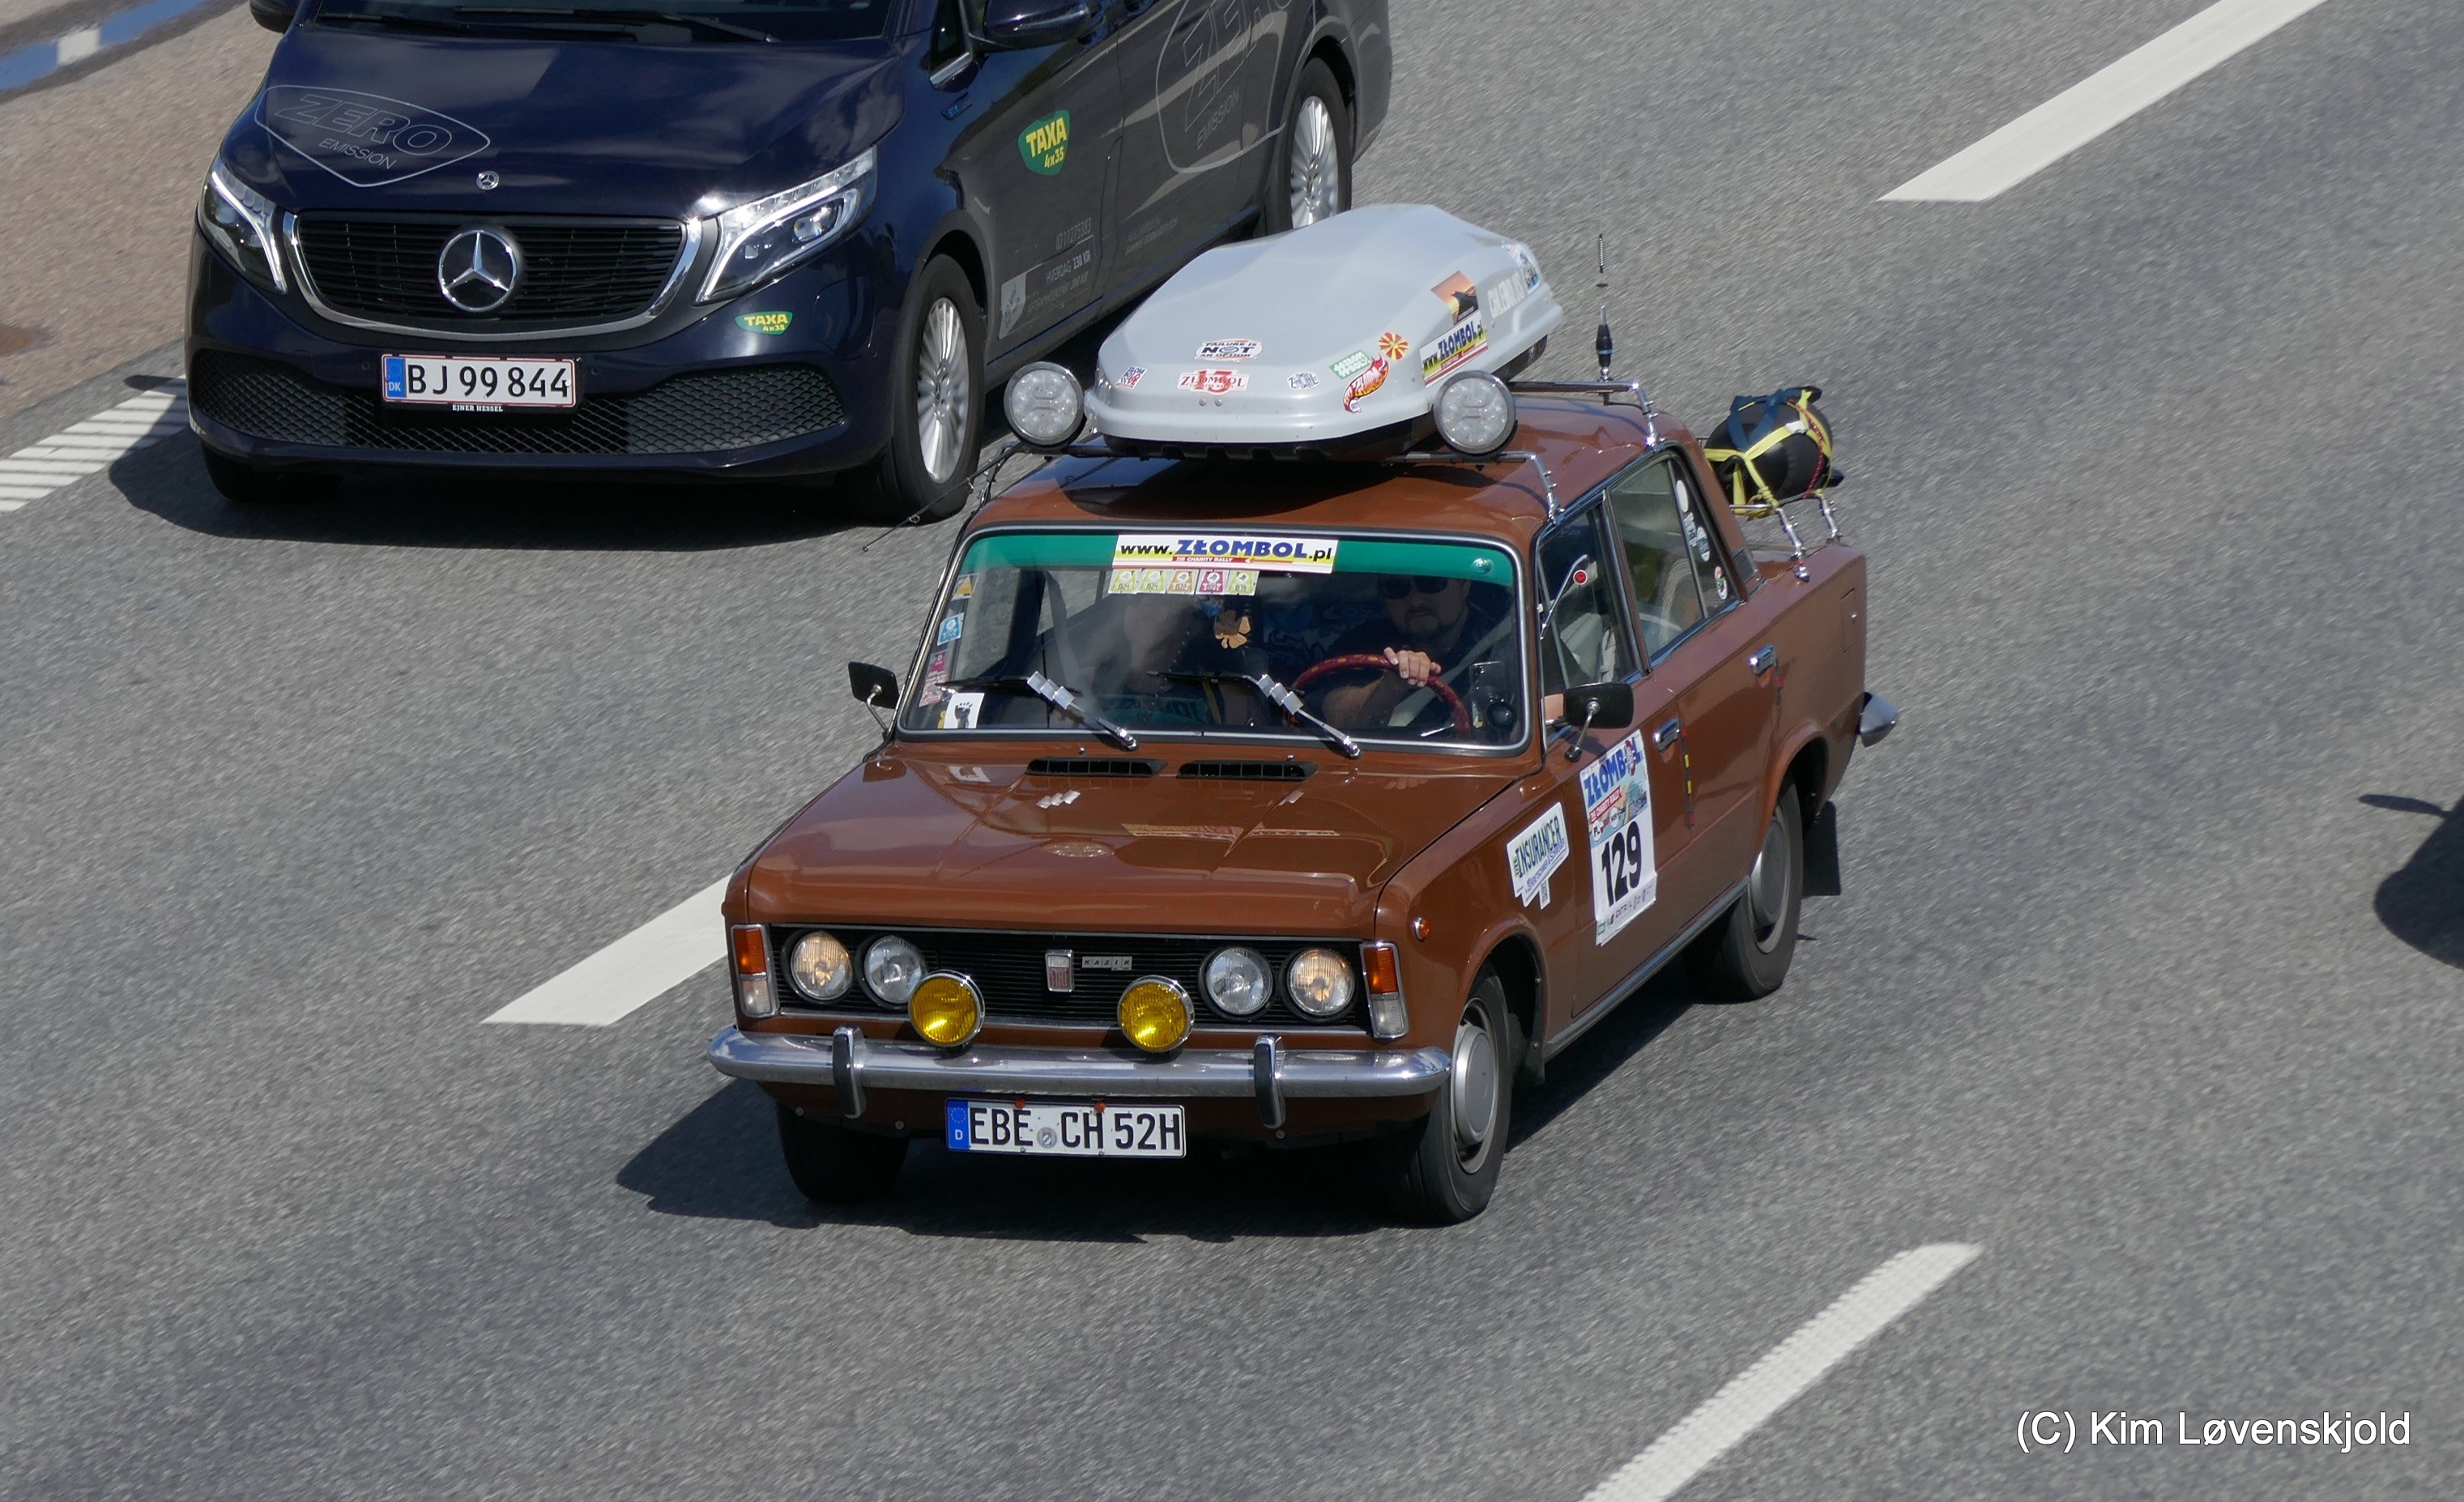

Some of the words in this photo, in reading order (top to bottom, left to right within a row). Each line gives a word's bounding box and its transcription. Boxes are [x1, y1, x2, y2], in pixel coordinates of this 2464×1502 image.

[275, 94, 453, 156] ZERO
[1025, 117, 1067, 158] TAXA
[319, 138, 397, 169] EMISSION
[1044, 146, 1064, 168] 4x35
[744, 314, 788, 326] TAXA
[389, 382, 401, 391] DK
[407, 365, 448, 395] BJ
[459, 366, 498, 397] 99
[507, 367, 568, 398] 844
[1601, 821, 1642, 907] 129
[955, 1129, 963, 1140] D
[970, 1107, 1034, 1146] EBE
[1061, 1112, 1103, 1149] CH
[1115, 1112, 1181, 1150] 52H
